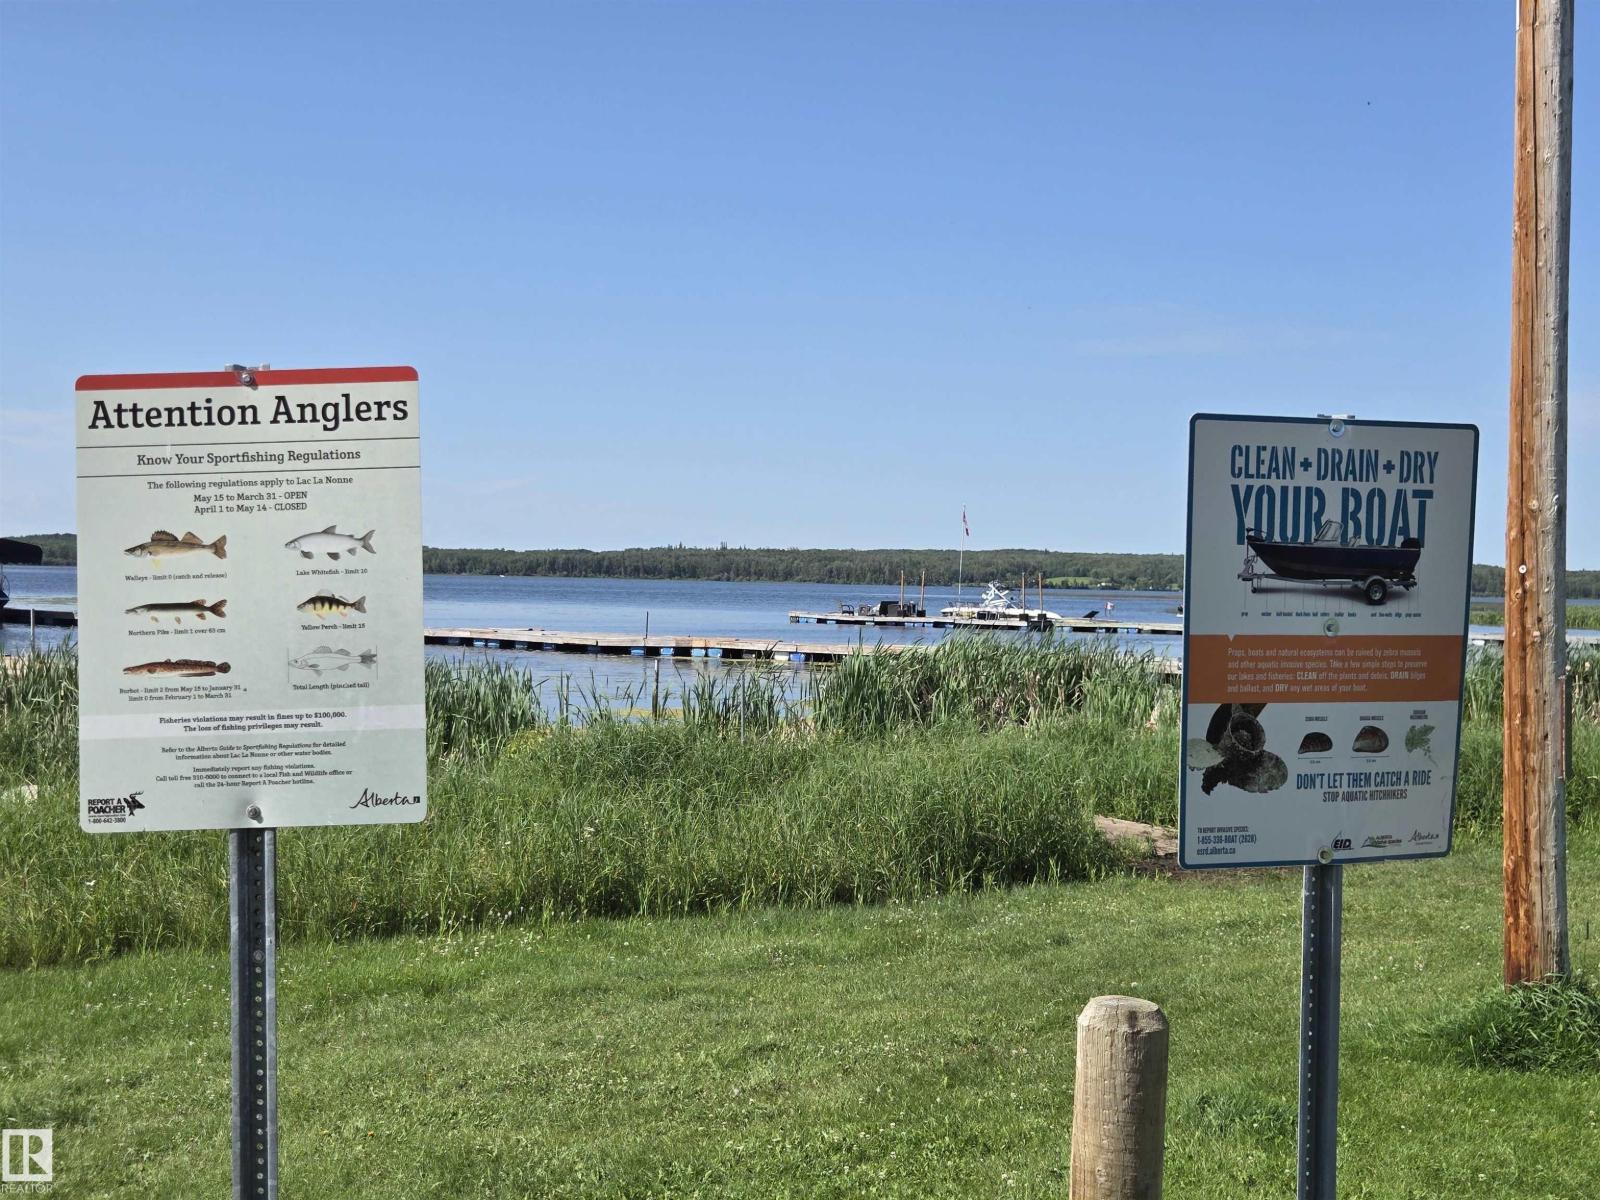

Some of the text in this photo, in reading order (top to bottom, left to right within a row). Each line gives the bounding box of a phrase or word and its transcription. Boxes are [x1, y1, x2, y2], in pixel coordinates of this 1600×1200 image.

[88, 393, 409, 431] Attention Anglers
[137, 449, 361, 466] Know Your Sportfishing Regulations
[1230, 444, 1439, 484] CLEAN DRAIN DRY
[147, 481, 163, 489] The
[166, 480, 206, 489] following
[208, 479, 258, 489] regulations
[260, 478, 283, 487] apply
[296, 477, 311, 485] Lac
[326, 476, 353, 484] Nonne
[193, 494, 211, 503] May
[237, 493, 264, 501] March
[267, 492, 276, 500] 31
[284, 491, 307, 499] OPEN
[194, 505, 217, 515] April
[236, 504, 254, 513] May
[274, 502, 307, 511] CLOSED
[1230, 484, 1434, 548] YOUR BOAT
[1248, 648, 1264, 656] boats
[1266, 648, 1277, 656] and
[1278, 648, 1299, 656] natural
[1375, 648, 1382, 658] by
[1296, 671, 1317, 680] CLEAN
[1338, 671, 1357, 681] plants
[1390, 671, 1409, 679] DRAIN
[309, 683, 329, 691] Length
[1275, 683, 1289, 692] DRY
[1339, 685, 1352, 693] your
[314, 711, 347, 719] $100,000.
[248, 723, 282, 731] privileges
[243, 744, 277, 752] Sportfishing
[1296, 769, 1432, 790] DON'T LET THEM CATCH A RIDE
[349, 787, 416, 809] Alberta
[1323, 788, 1408, 803] STOP AQUATIC HITCHHIKERS
[88, 805, 126, 814] POACHER
[1333, 838, 1352, 849] EID
